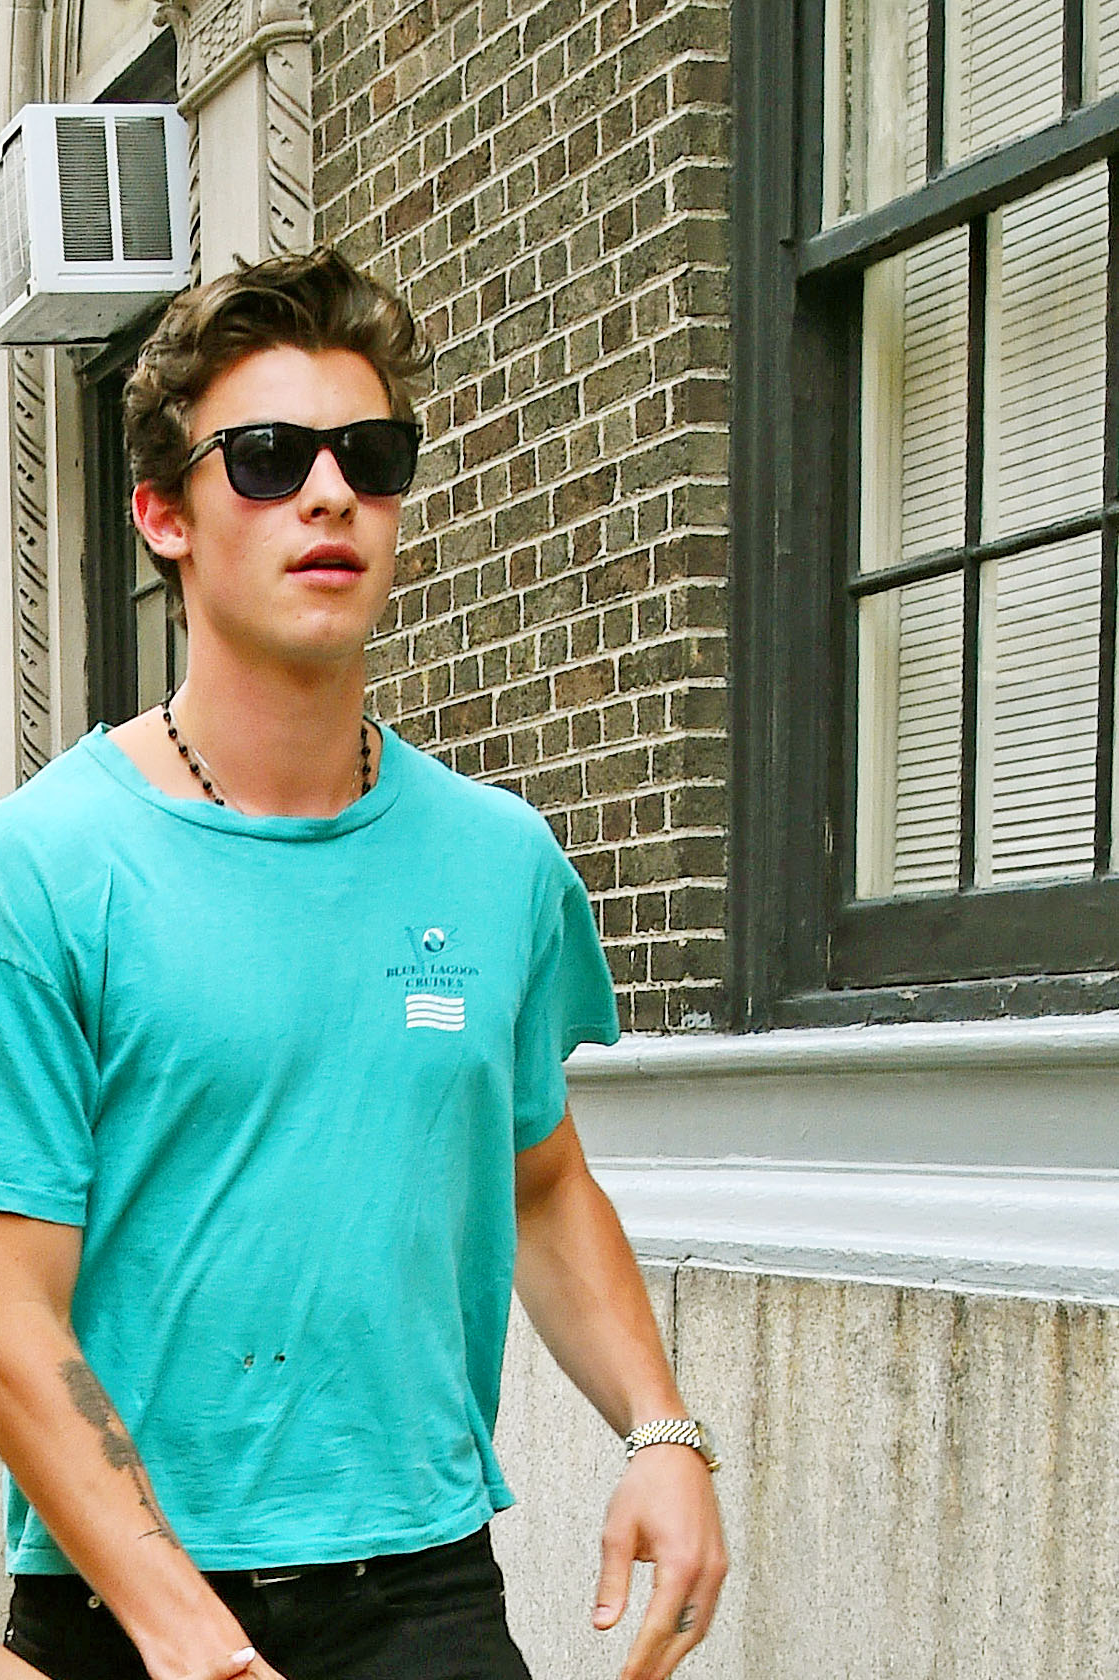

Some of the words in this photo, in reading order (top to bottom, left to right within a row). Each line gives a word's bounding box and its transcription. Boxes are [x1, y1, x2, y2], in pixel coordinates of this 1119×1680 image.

[386, 965, 420, 978] BLUE
[430, 964, 480, 976] LAGOON
[405, 977, 463, 988] CRUISES
